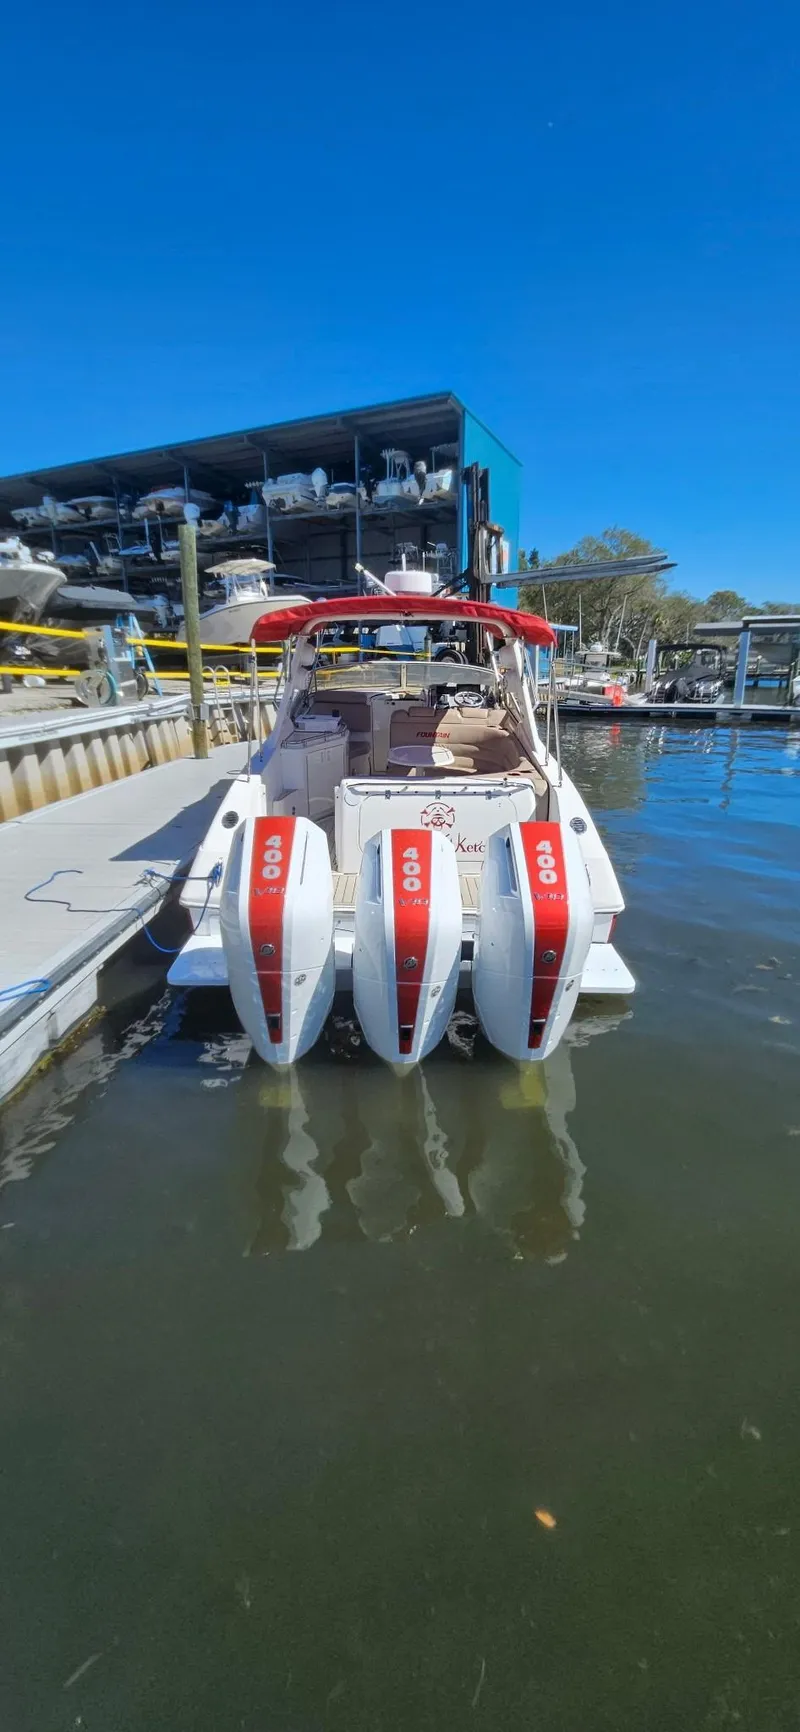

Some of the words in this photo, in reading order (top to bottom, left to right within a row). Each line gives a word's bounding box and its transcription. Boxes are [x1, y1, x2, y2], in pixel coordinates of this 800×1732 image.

[416, 731, 450, 739] FOUNTAIN
[262, 835, 282, 880] 400
[402, 847, 422, 892] 400
[536, 840, 558, 884] 400
